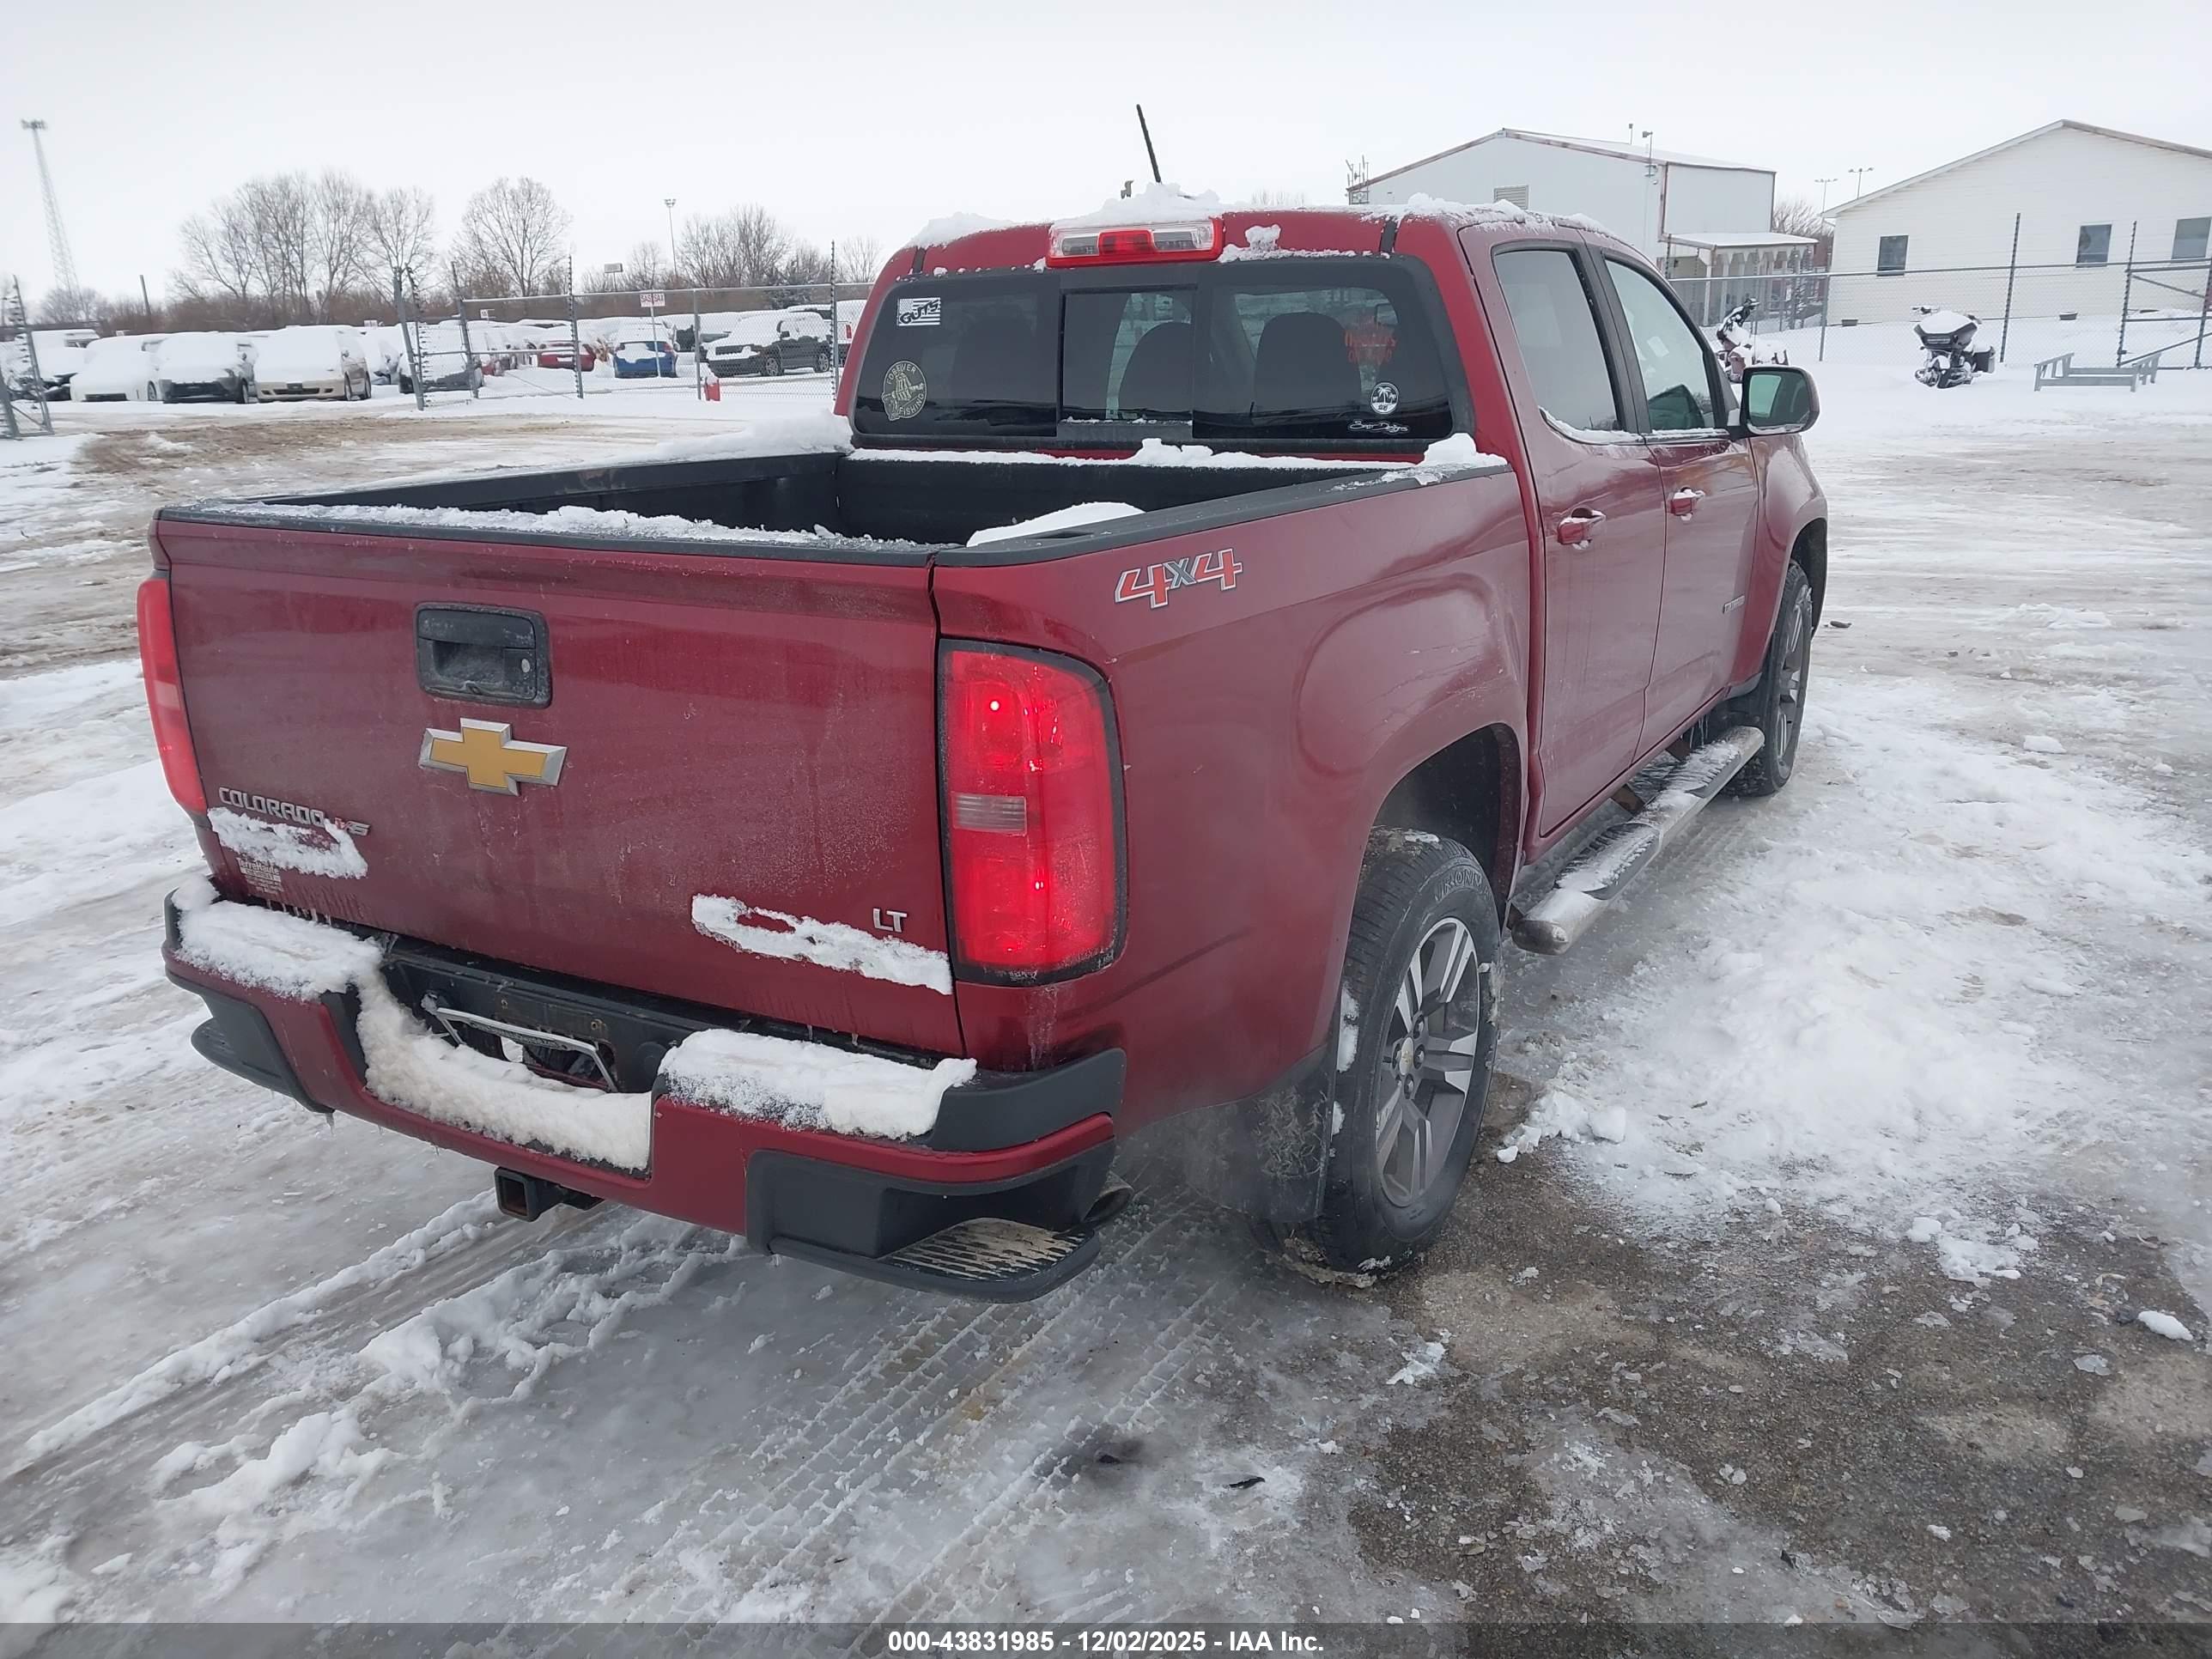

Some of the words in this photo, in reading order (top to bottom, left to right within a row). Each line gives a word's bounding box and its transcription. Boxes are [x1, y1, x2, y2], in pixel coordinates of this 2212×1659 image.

[900, 299, 939, 324] GUTS
[886, 363, 916, 385] FOREVER
[898, 393, 925, 416] FISHING
[218, 787, 325, 828] COLORADO
[872, 908, 908, 933] LT
